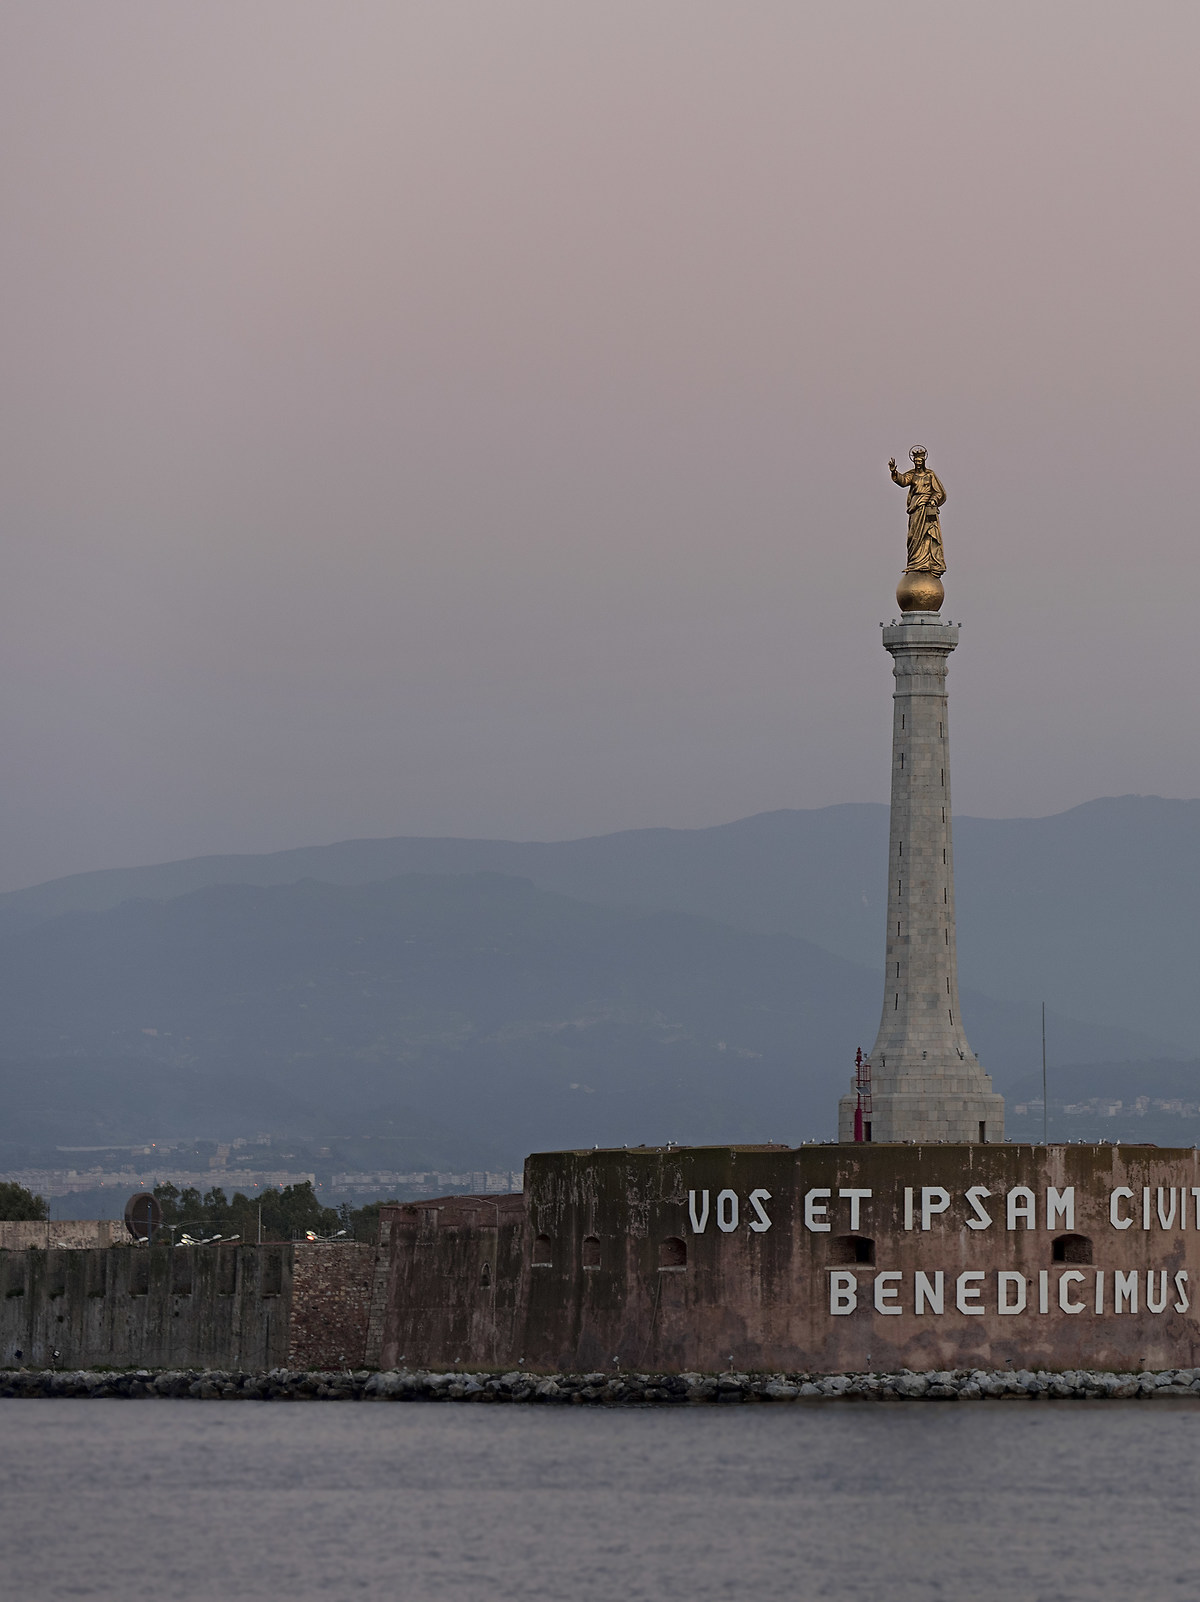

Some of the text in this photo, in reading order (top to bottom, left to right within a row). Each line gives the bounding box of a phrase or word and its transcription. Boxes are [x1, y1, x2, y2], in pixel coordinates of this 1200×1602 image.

[688, 1187, 774, 1234] VOS
[803, 1187, 873, 1233] ET
[904, 1186, 1075, 1231] IPSAM
[830, 1270, 1190, 1315] BENEDICIMUS
